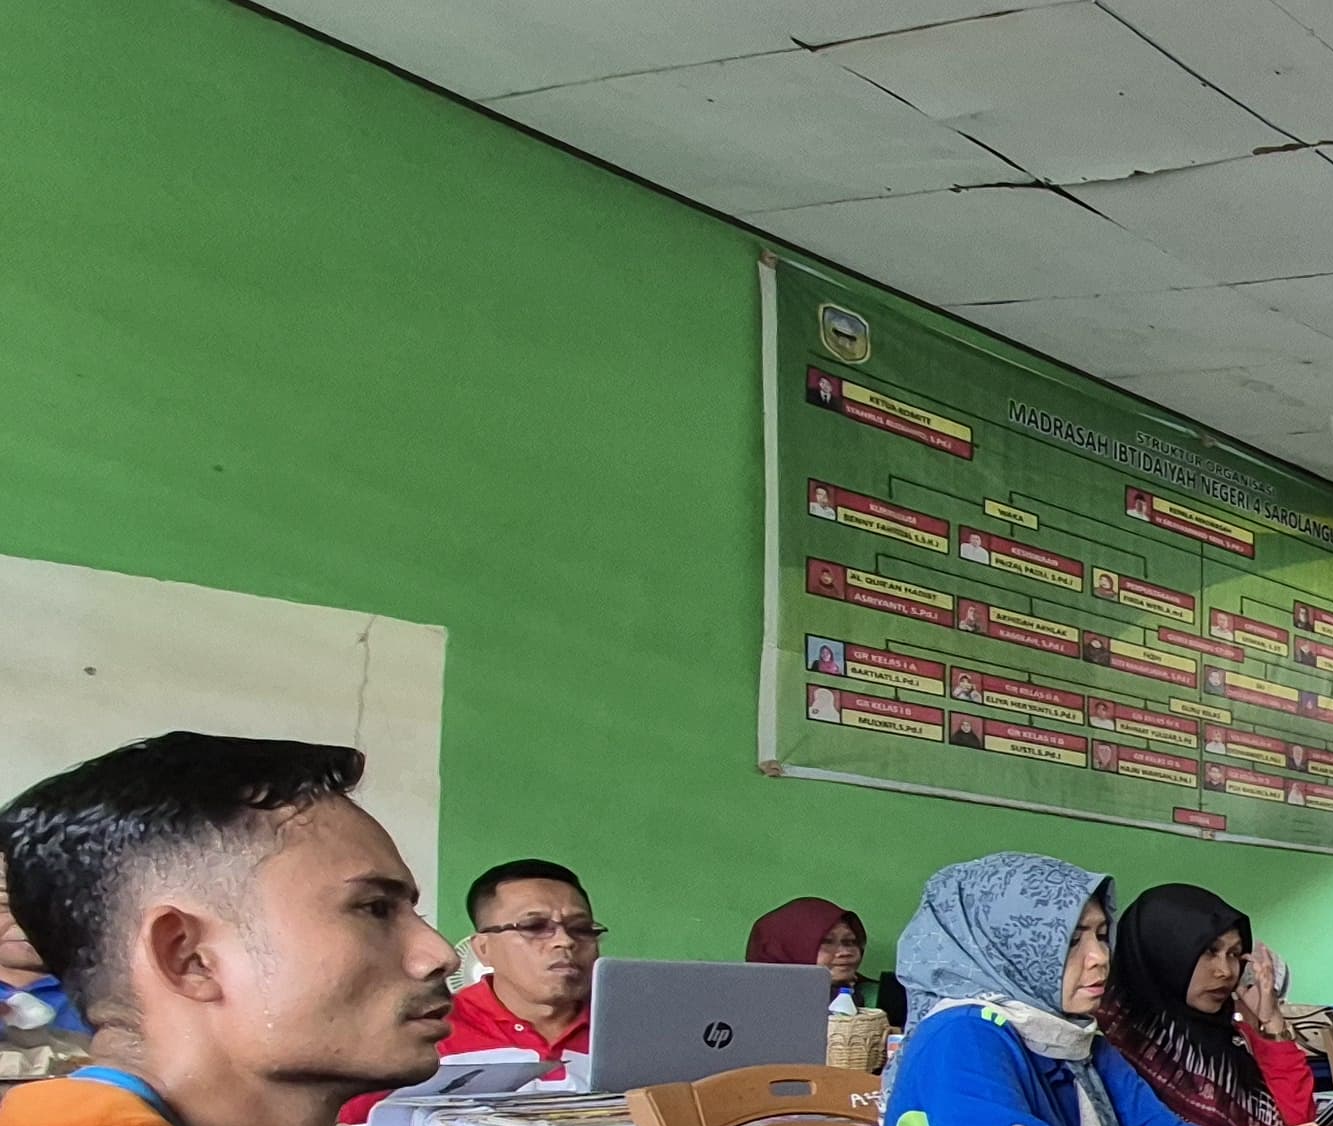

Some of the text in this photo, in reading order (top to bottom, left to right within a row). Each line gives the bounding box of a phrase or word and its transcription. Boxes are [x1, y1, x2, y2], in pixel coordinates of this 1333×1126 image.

[1008, 399, 1108, 457] MADRASAH
[1112, 439, 1197, 490] IBTIDAIYAH
[1201, 475, 1249, 512] NEGERI
[1252, 496, 1262, 514] 4
[871, 653, 901, 668] KELAS
[704, 1021, 733, 1049] hp
